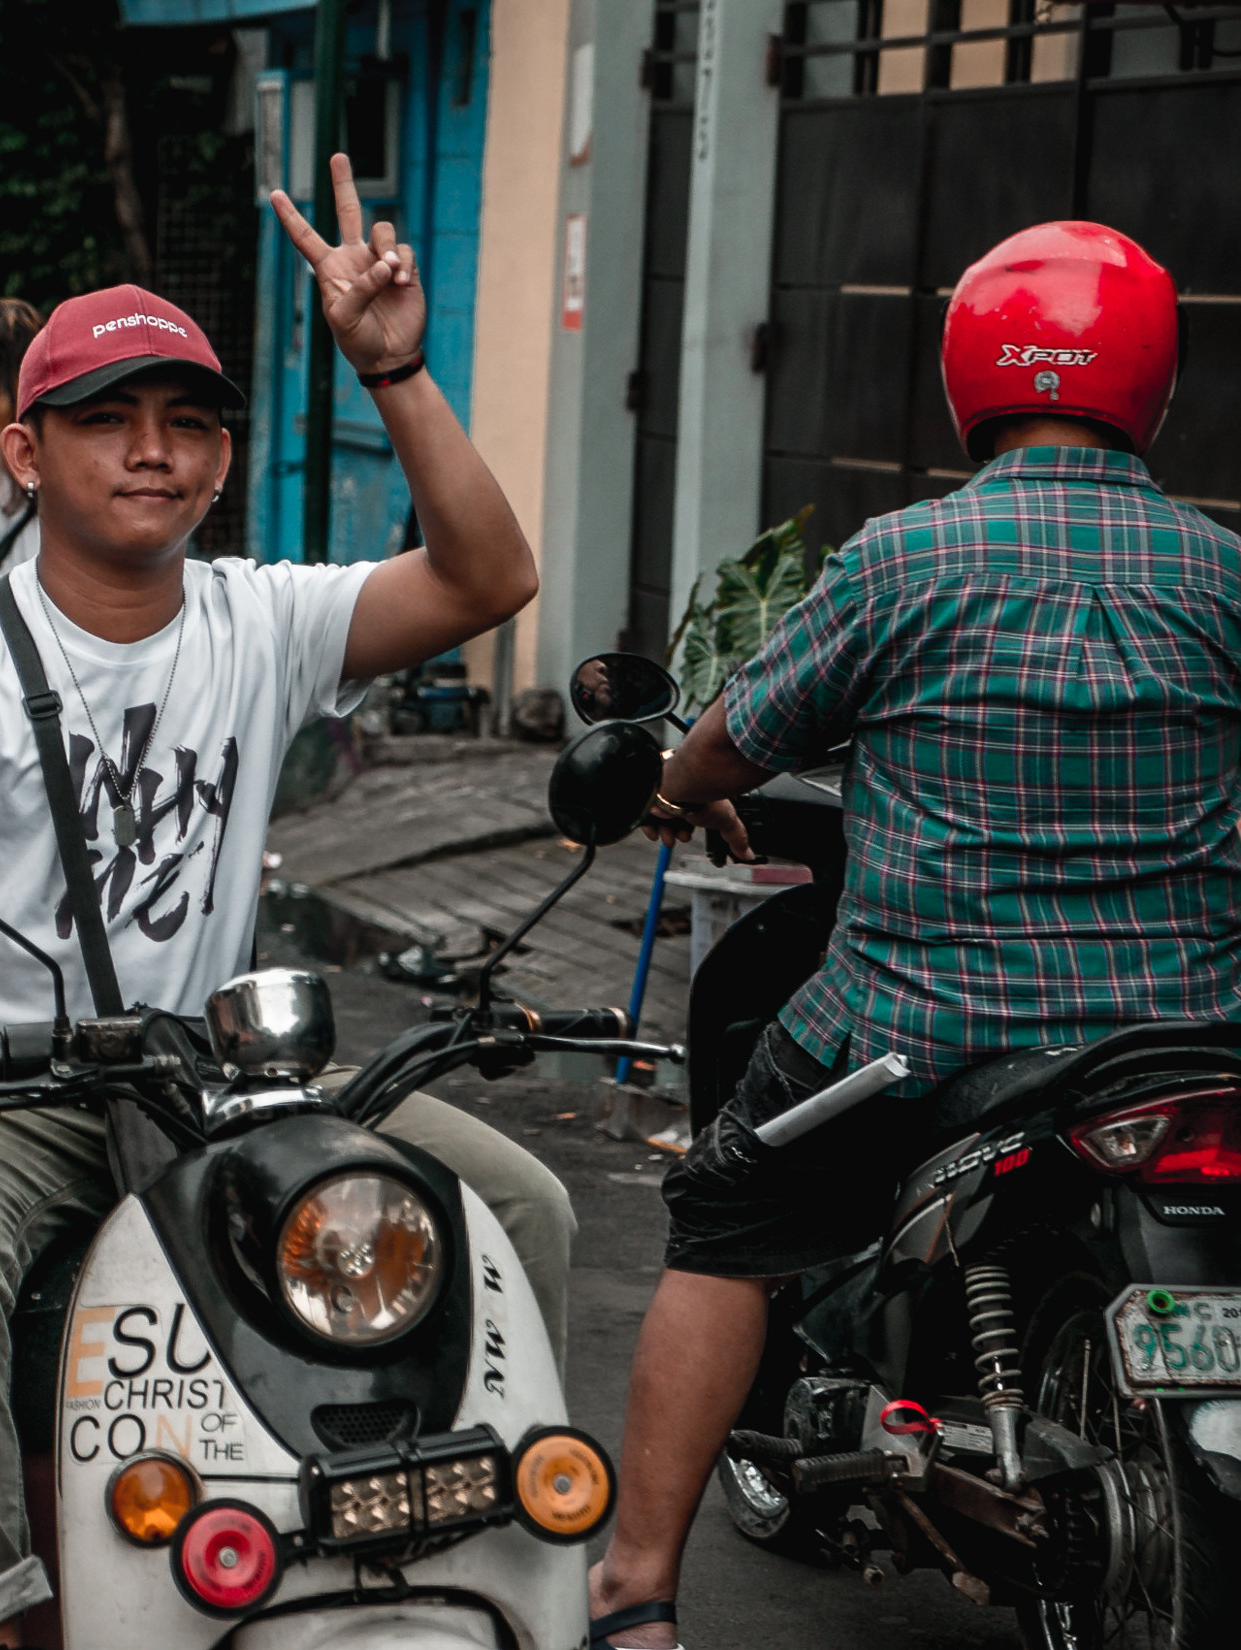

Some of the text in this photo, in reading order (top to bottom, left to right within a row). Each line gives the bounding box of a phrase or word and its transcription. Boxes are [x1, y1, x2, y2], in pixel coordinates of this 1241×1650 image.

[92, 312, 188, 339] penshoppe
[994, 1147, 1030, 1177] 100
[1163, 1205, 1226, 1217] HONDA
[201, 1412, 238, 1433] OF
[198, 1438, 245, 1462] THE
